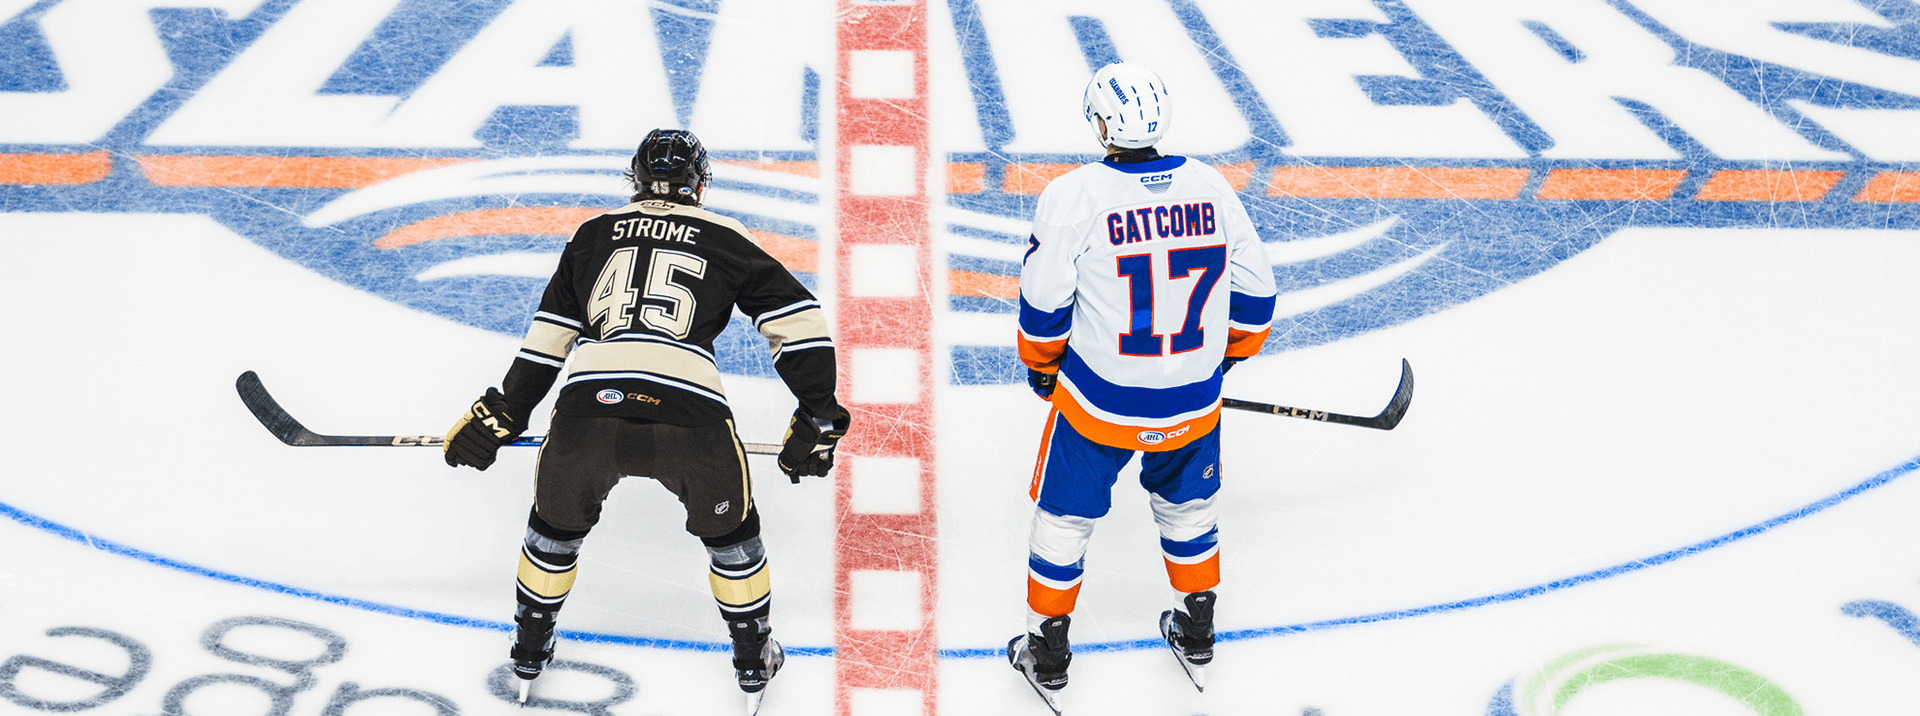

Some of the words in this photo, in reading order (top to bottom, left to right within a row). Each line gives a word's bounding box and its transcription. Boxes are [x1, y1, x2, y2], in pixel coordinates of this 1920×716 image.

[1109, 77, 1129, 105] ISLANDERS
[1148, 121, 1158, 133] 17
[1140, 173, 1173, 183] CCM
[650, 181, 670, 194] 45
[612, 217, 700, 246] STROME
[1107, 202, 1216, 246] GATCOMB
[588, 247, 708, 340] 45
[1115, 243, 1227, 356] 17
[627, 393, 661, 405] CCM
[1273, 406, 1328, 421] CCM
[1167, 425, 1190, 438] CCM
